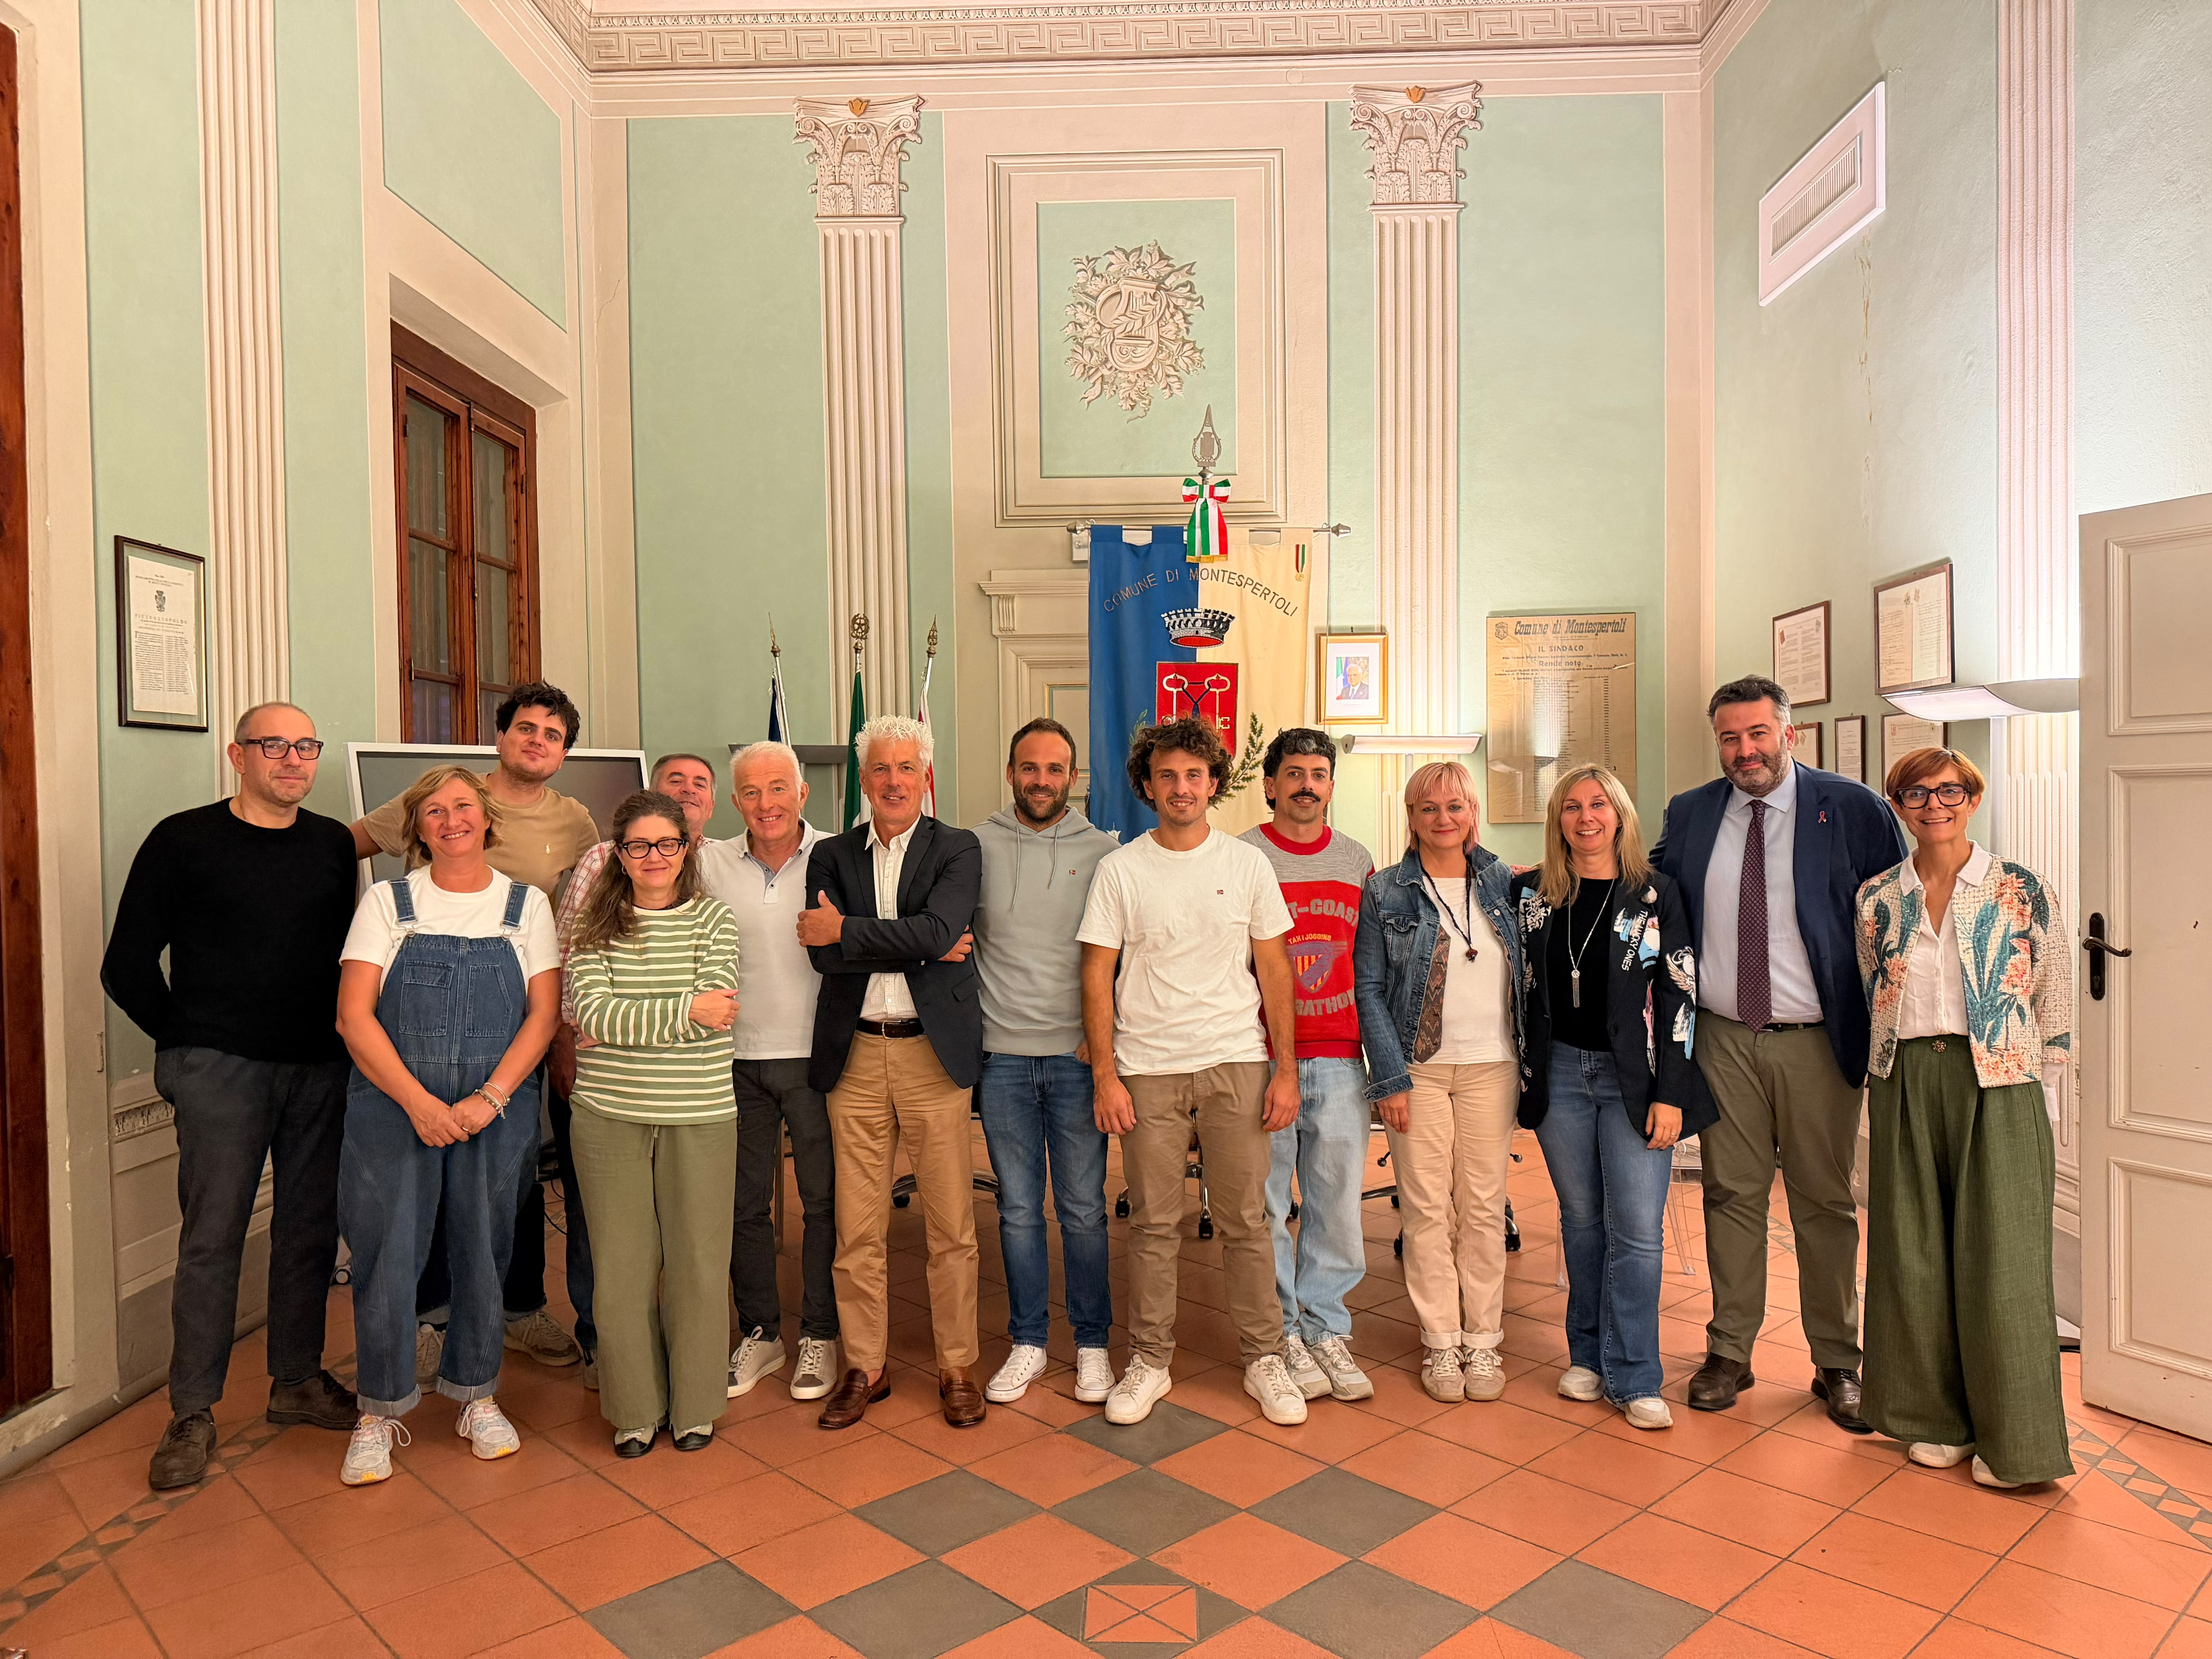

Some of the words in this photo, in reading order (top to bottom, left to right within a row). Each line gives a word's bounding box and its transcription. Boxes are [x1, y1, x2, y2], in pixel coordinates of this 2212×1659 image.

[1104, 573, 1158, 611] COMUNE
[1166, 569, 1179, 582] DI
[1189, 568, 1298, 617] MONTESPERTOLI
[1514, 621, 1548, 635] Comune
[1552, 619, 1562, 634] di
[1565, 618, 1627, 636] Montespertoli
[1637, 910, 1648, 925] THE
[1629, 925, 1644, 950] LUCKY
[1621, 949, 1635, 971] ONES
